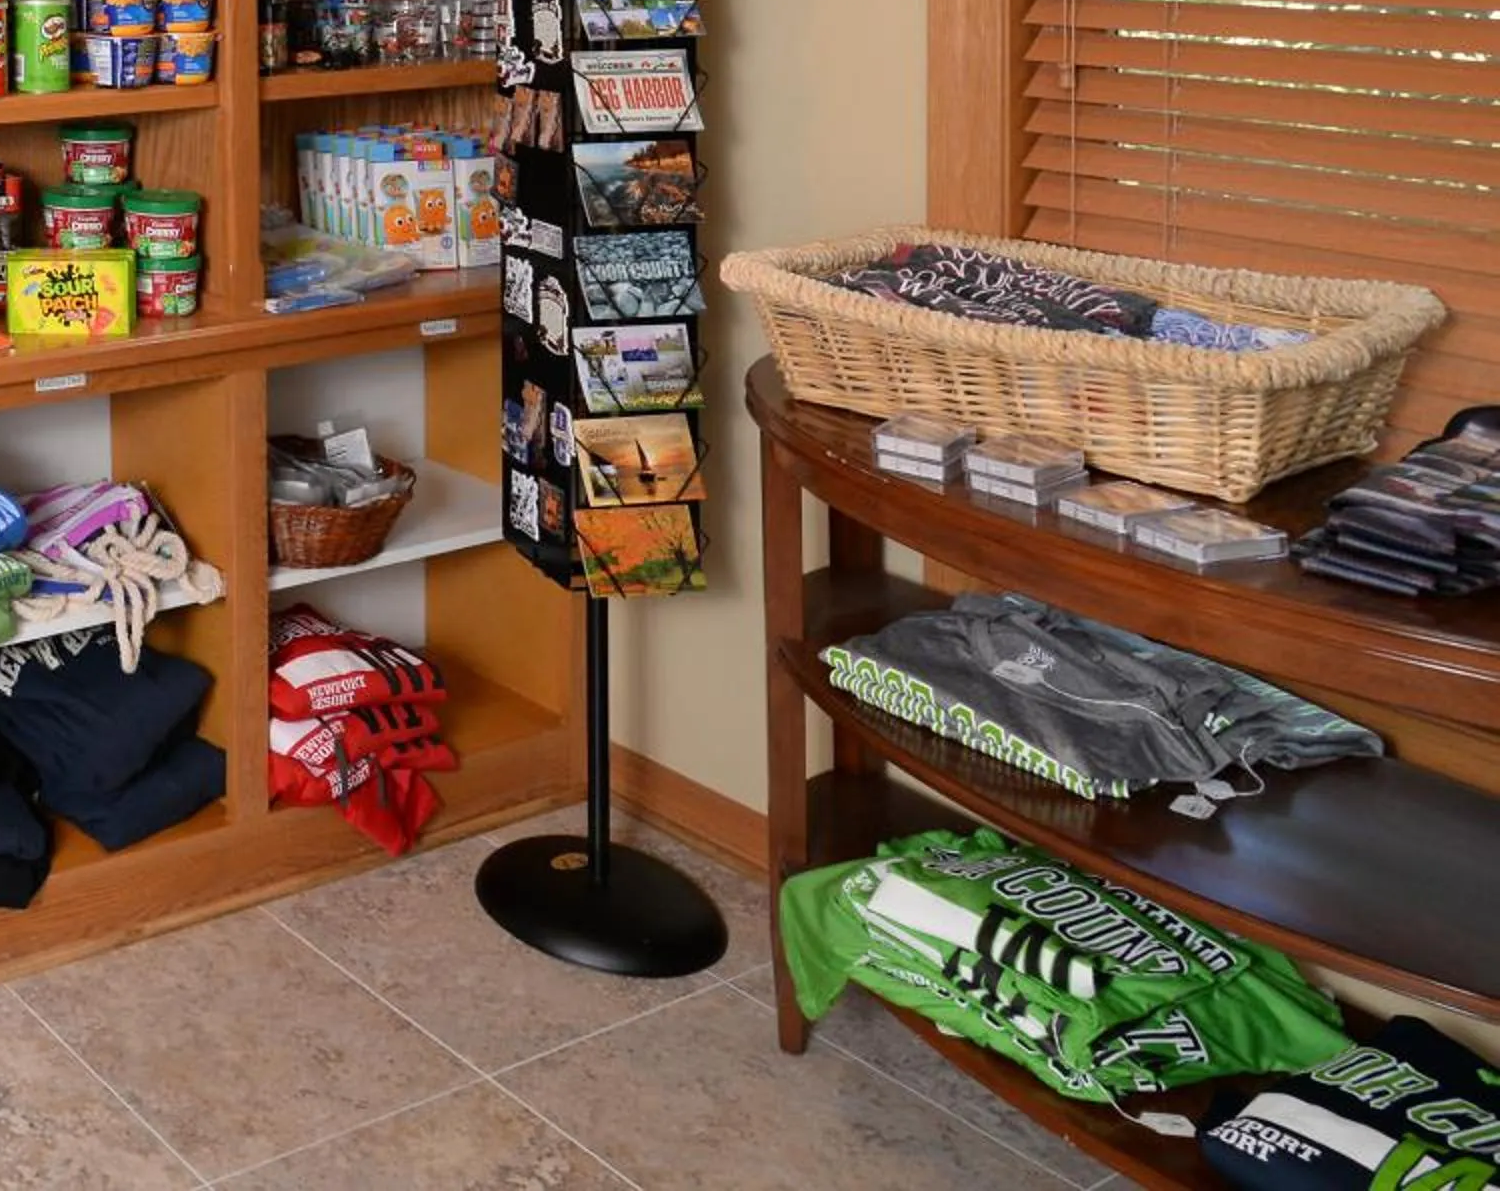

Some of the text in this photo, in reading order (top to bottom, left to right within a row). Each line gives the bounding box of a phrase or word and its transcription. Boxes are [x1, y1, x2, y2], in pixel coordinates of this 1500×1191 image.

[621, 74, 688, 111] HARBOR
[42, 279, 93, 295] SOUR
[40, 294, 100, 311] PATCH
[308, 674, 368, 700] NEWPORT
